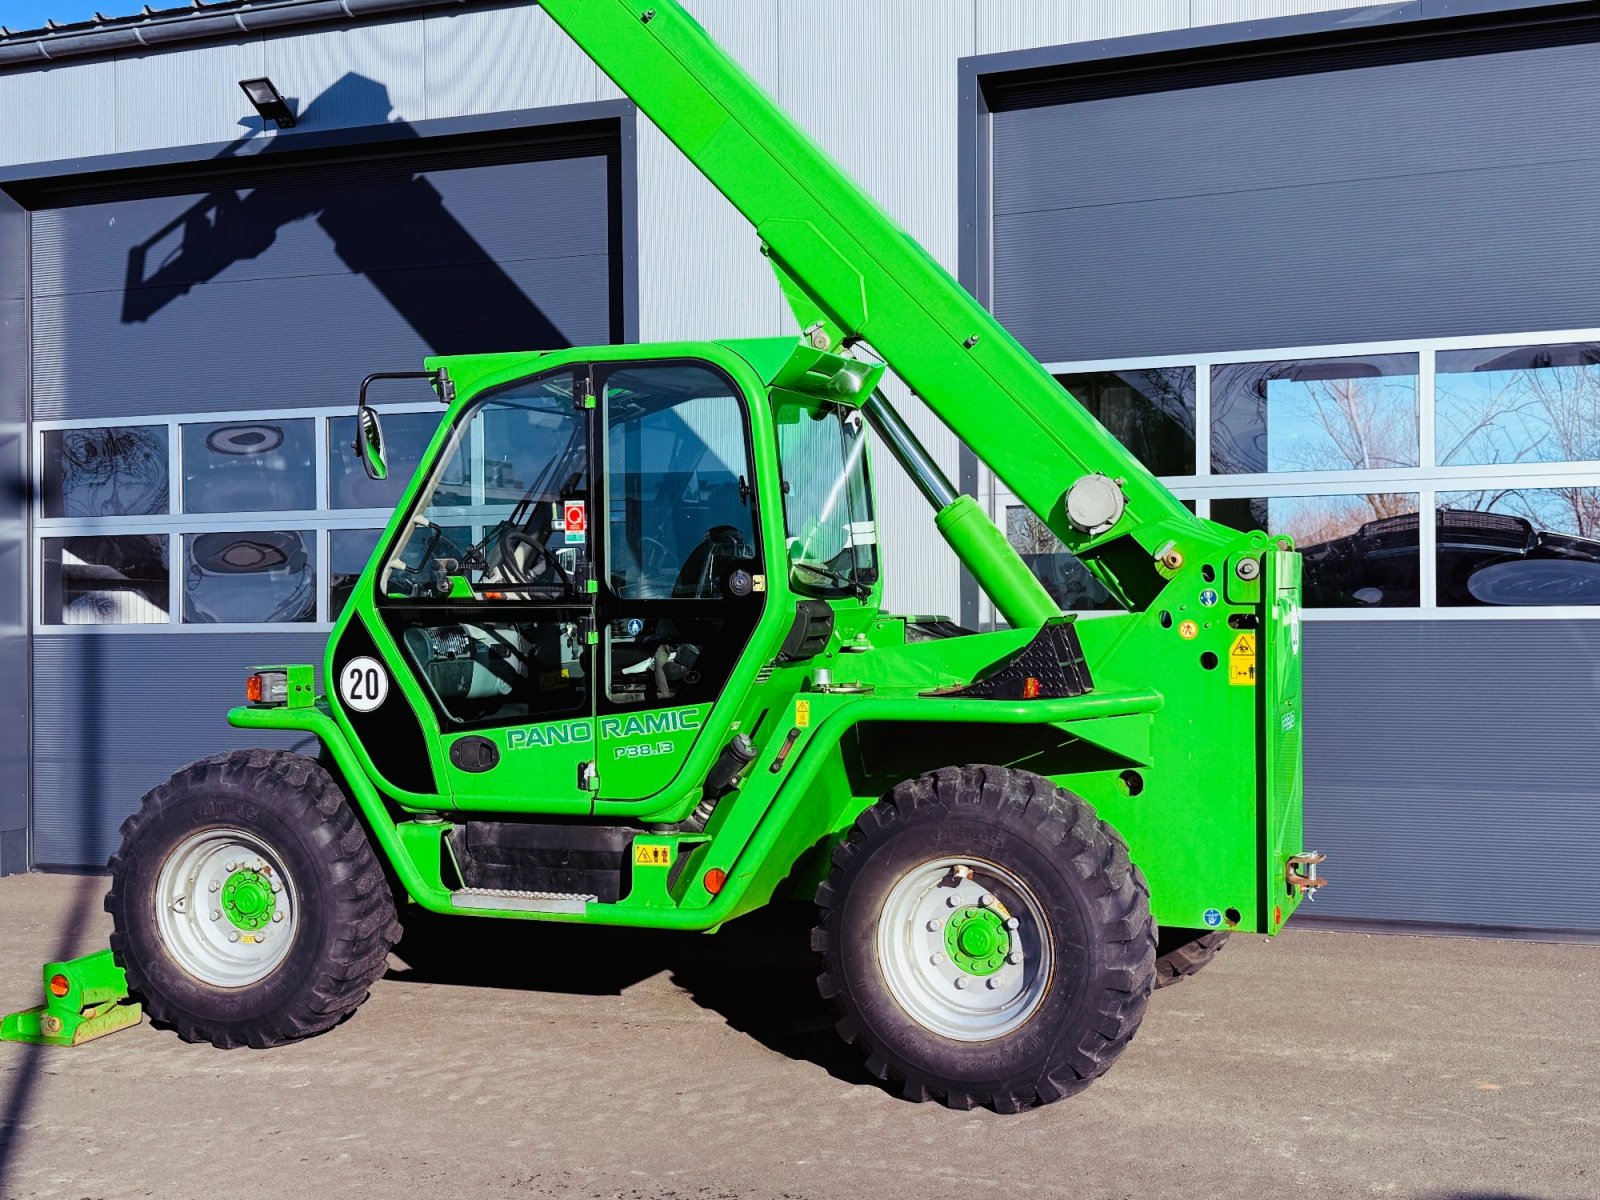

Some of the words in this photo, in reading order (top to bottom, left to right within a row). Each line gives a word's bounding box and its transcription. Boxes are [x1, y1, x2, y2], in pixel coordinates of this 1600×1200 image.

[350, 668, 379, 700] 20
[506, 722, 591, 750] PANO
[601, 709, 700, 739] RAMIC
[614, 741, 675, 760] P38.13
